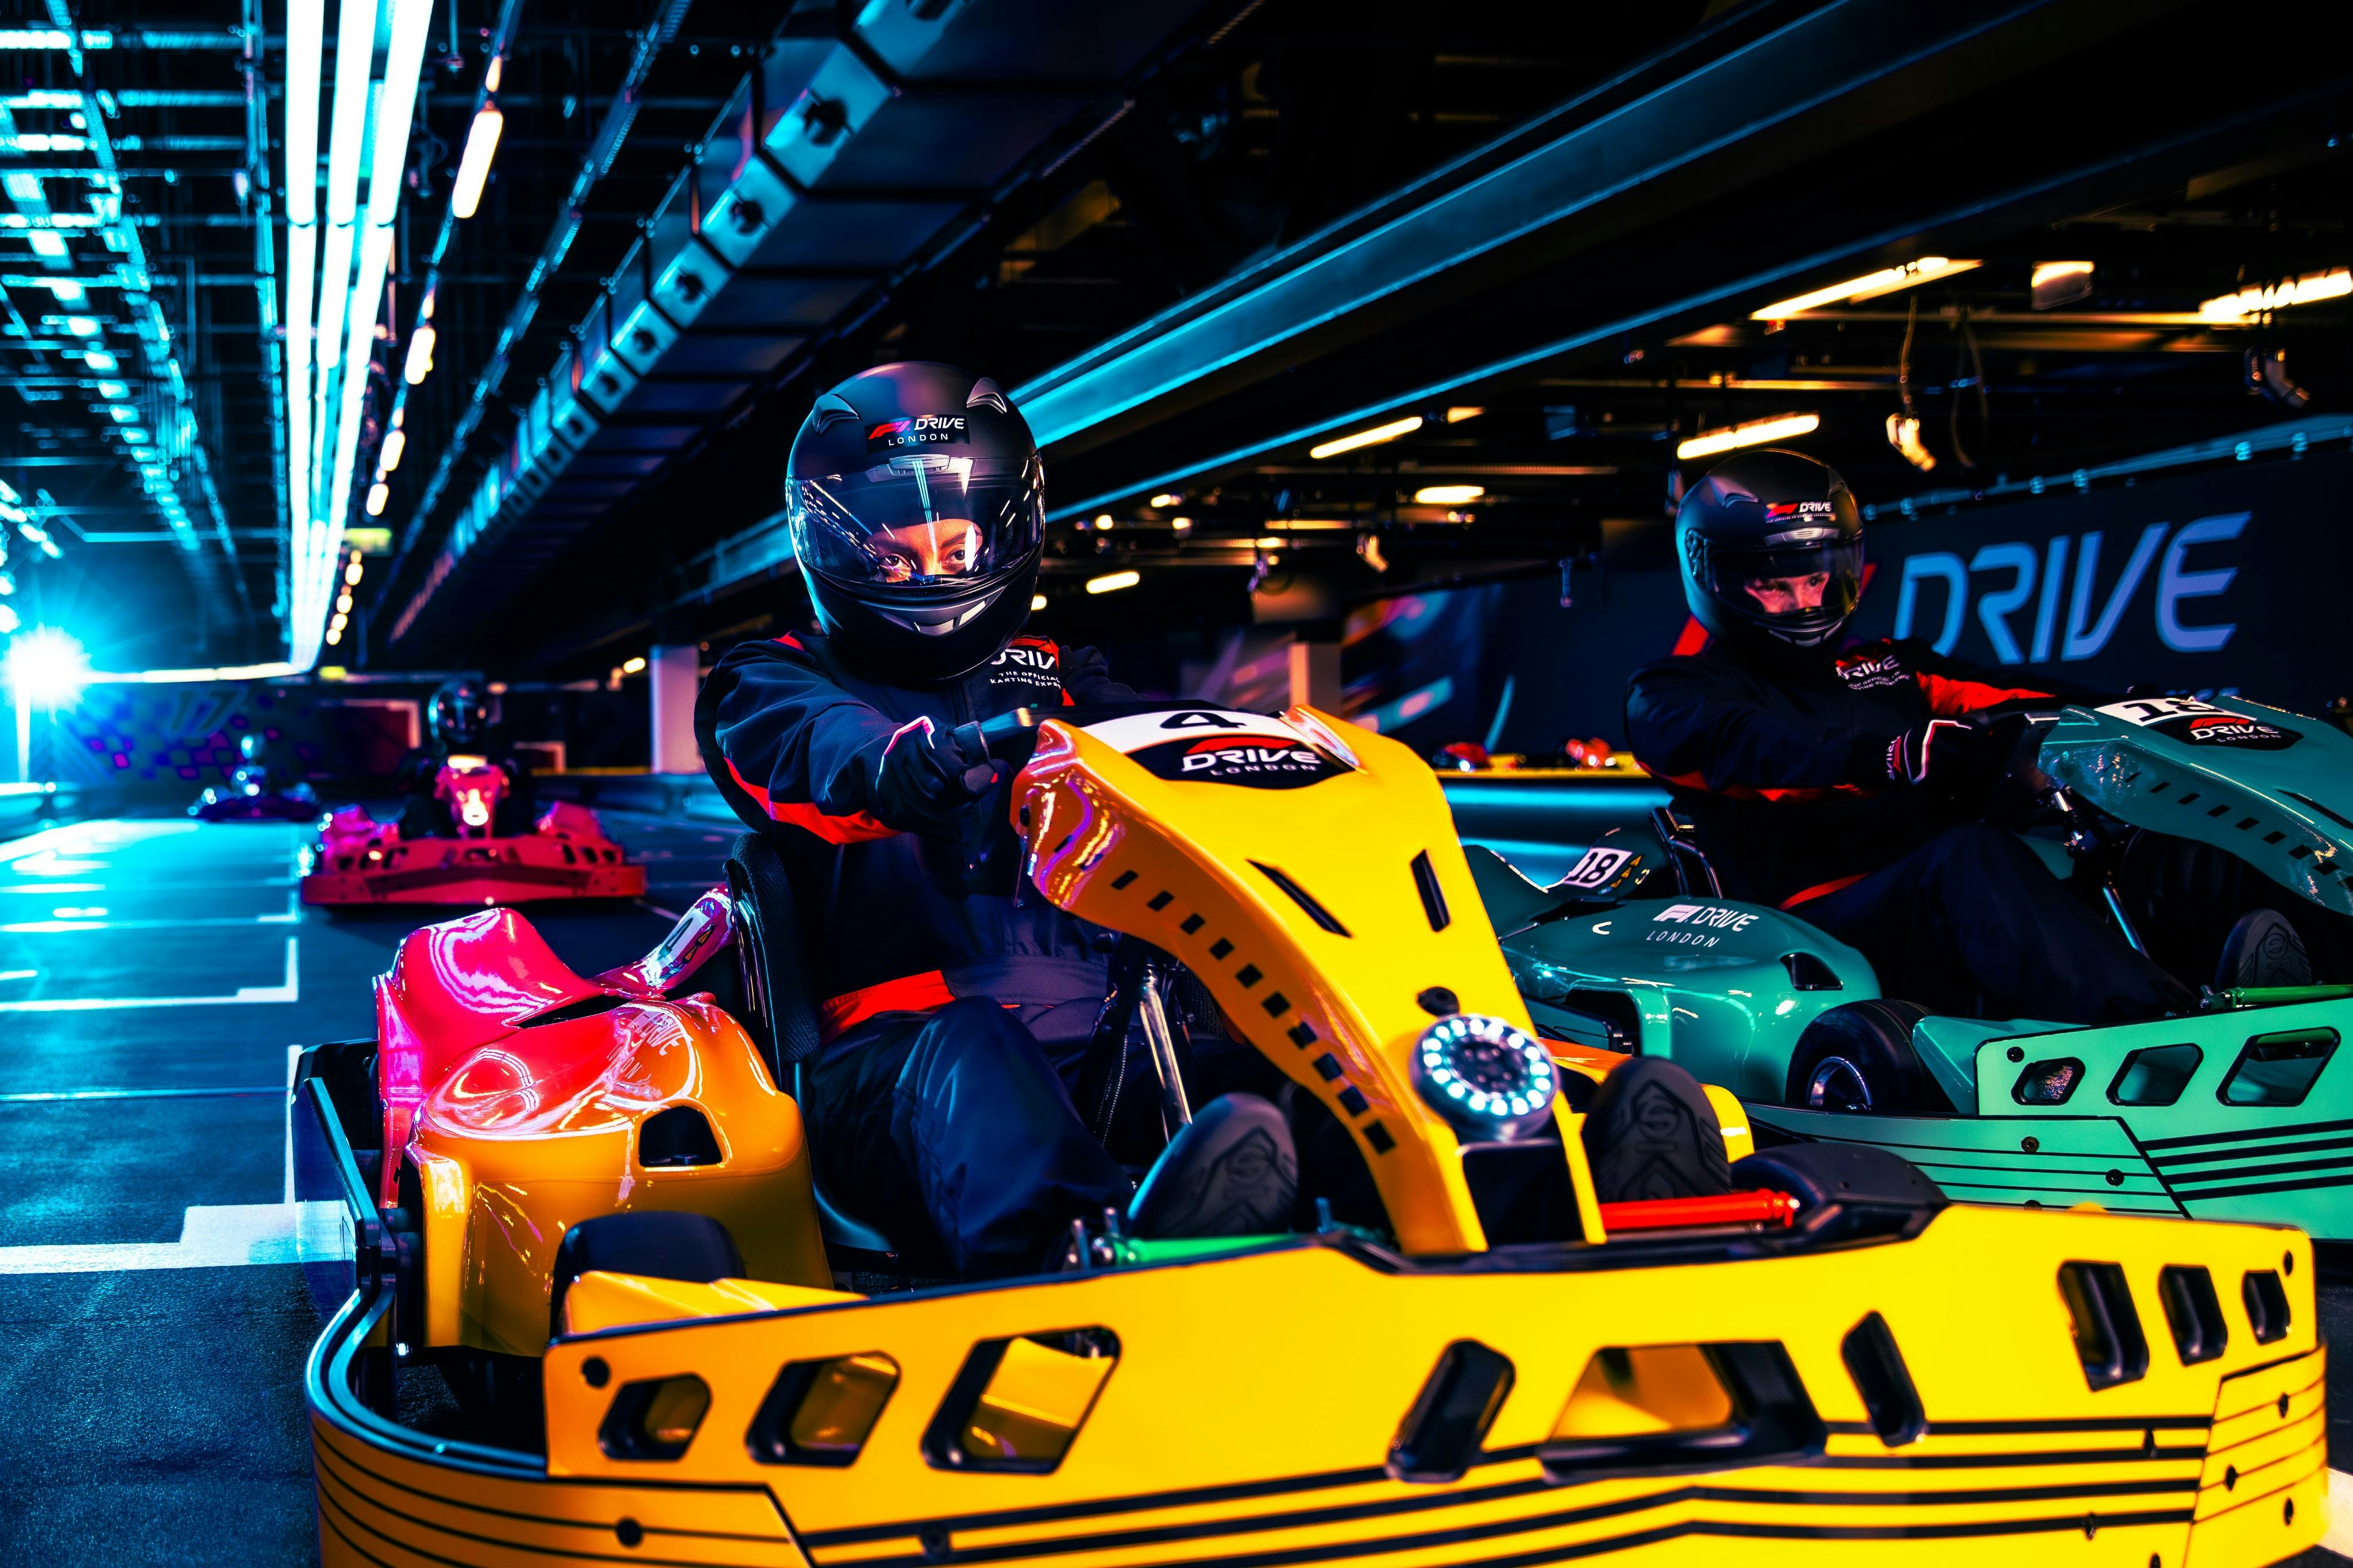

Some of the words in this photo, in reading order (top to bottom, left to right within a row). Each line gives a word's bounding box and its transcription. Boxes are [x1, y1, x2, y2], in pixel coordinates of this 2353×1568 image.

[914, 418, 965, 430] DRIVE
[889, 434, 948, 446] LONDON
[1799, 501, 1832, 512] DRIVE
[1893, 511, 2252, 665] DRIVE
[1022, 672, 1060, 683] OFFICIAL
[1159, 712, 1248, 729] 4
[2190, 725, 2279, 740] DRIVE
[1181, 749, 1321, 772] DRIVE
[1210, 764, 1317, 776] LONDON
[1565, 852, 1619, 883] 18
[1691, 907, 1760, 932] DRIVE
[1646, 930, 1720, 948] LONDON
